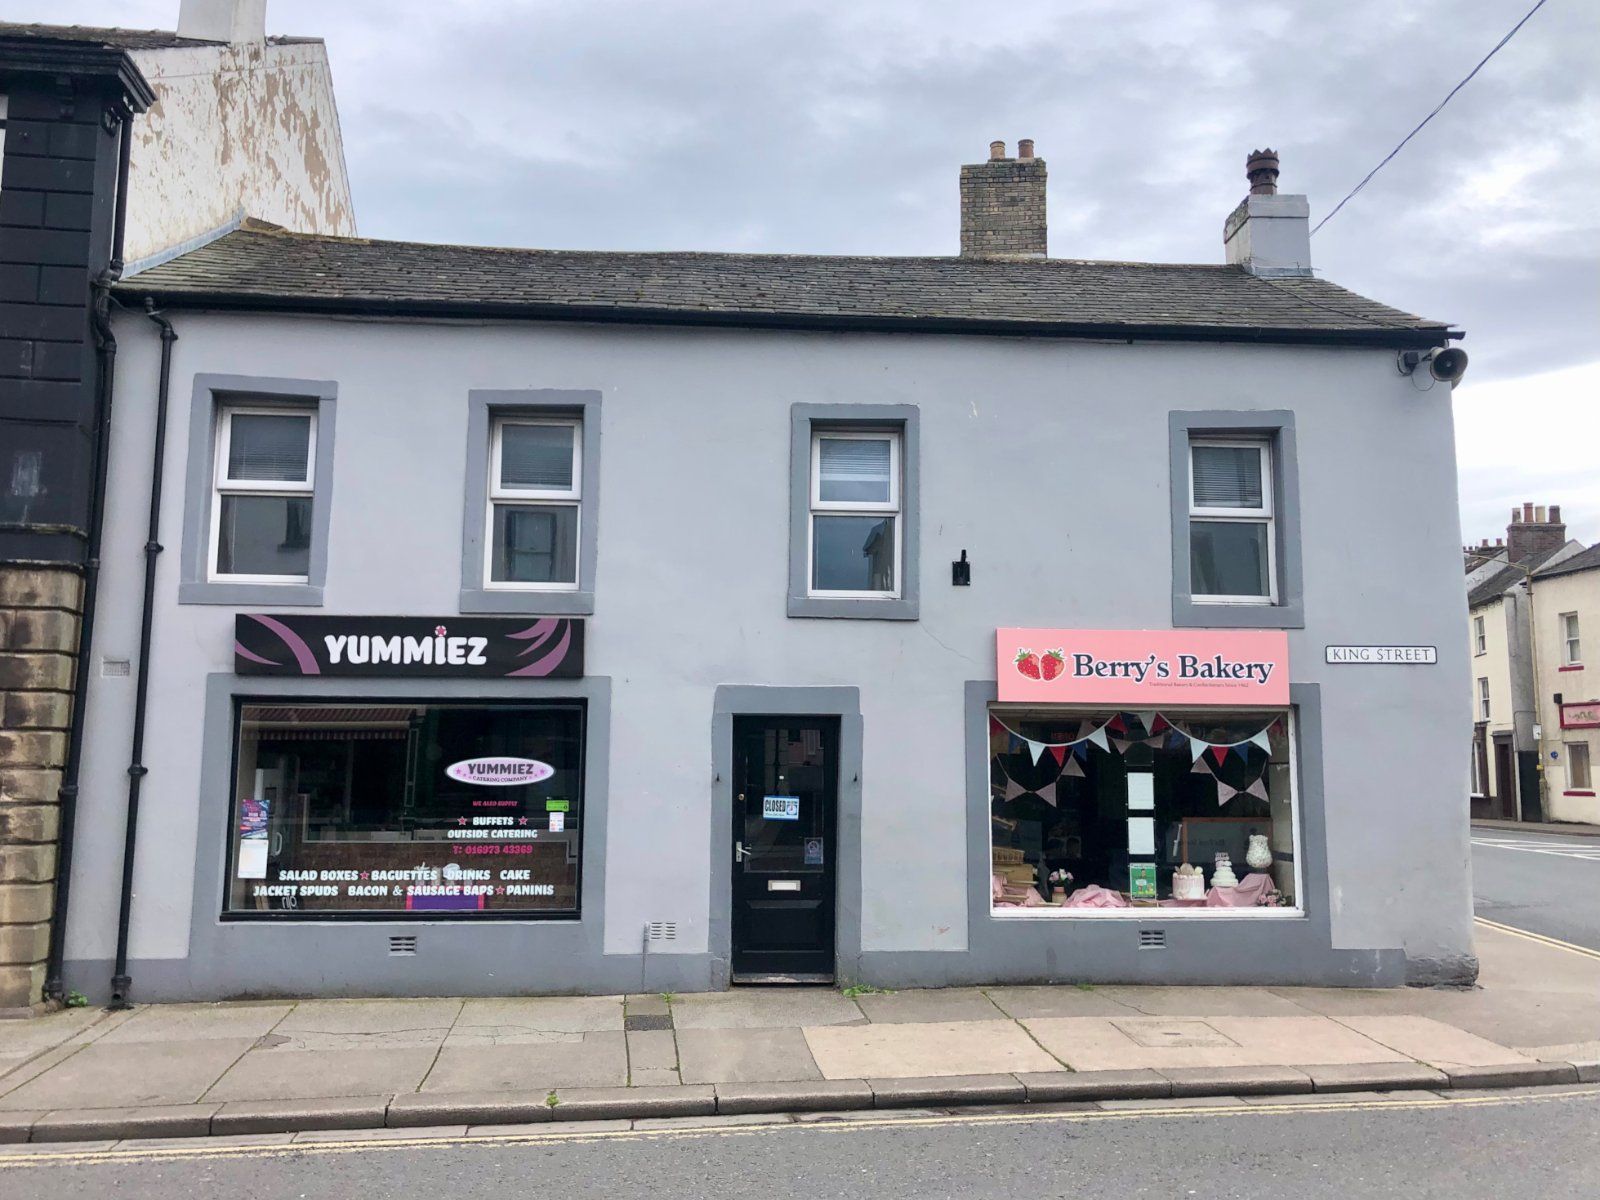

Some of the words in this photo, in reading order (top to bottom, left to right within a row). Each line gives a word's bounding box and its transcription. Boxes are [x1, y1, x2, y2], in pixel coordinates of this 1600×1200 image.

[1333, 648, 1370, 660] KING
[1377, 648, 1430, 660] STREET
[1073, 654, 1170, 682] Berry's
[1178, 655, 1273, 683] Bakery
[467, 763, 534, 775] YUMMIEZ
[472, 775, 500, 783] CATERING
[501, 775, 528, 783] COMPANY
[764, 799, 786, 812] CLOSED
[472, 816, 514, 826] BUFFETS
[447, 829, 489, 839] OUTSIDE
[491, 829, 538, 839] CATERING
[453, 845, 463, 855] T:
[465, 845, 500, 855] 016973
[503, 845, 533, 854] 43369
[279, 870, 318, 881] SALAD
[320, 870, 359, 881] BOXES
[371, 869, 437, 880] BAGUETTES
[448, 869, 491, 881] DRINKS
[500, 869, 531, 881] CAKE
[253, 885, 297, 897] JACKET
[299, 885, 339, 897] SPUDS
[348, 885, 388, 897] BACON
[392, 885, 404, 897] &
[407, 885, 461, 897] SAUSAGE
[463, 885, 494, 896] BAPS
[507, 885, 554, 896] PANINIS
